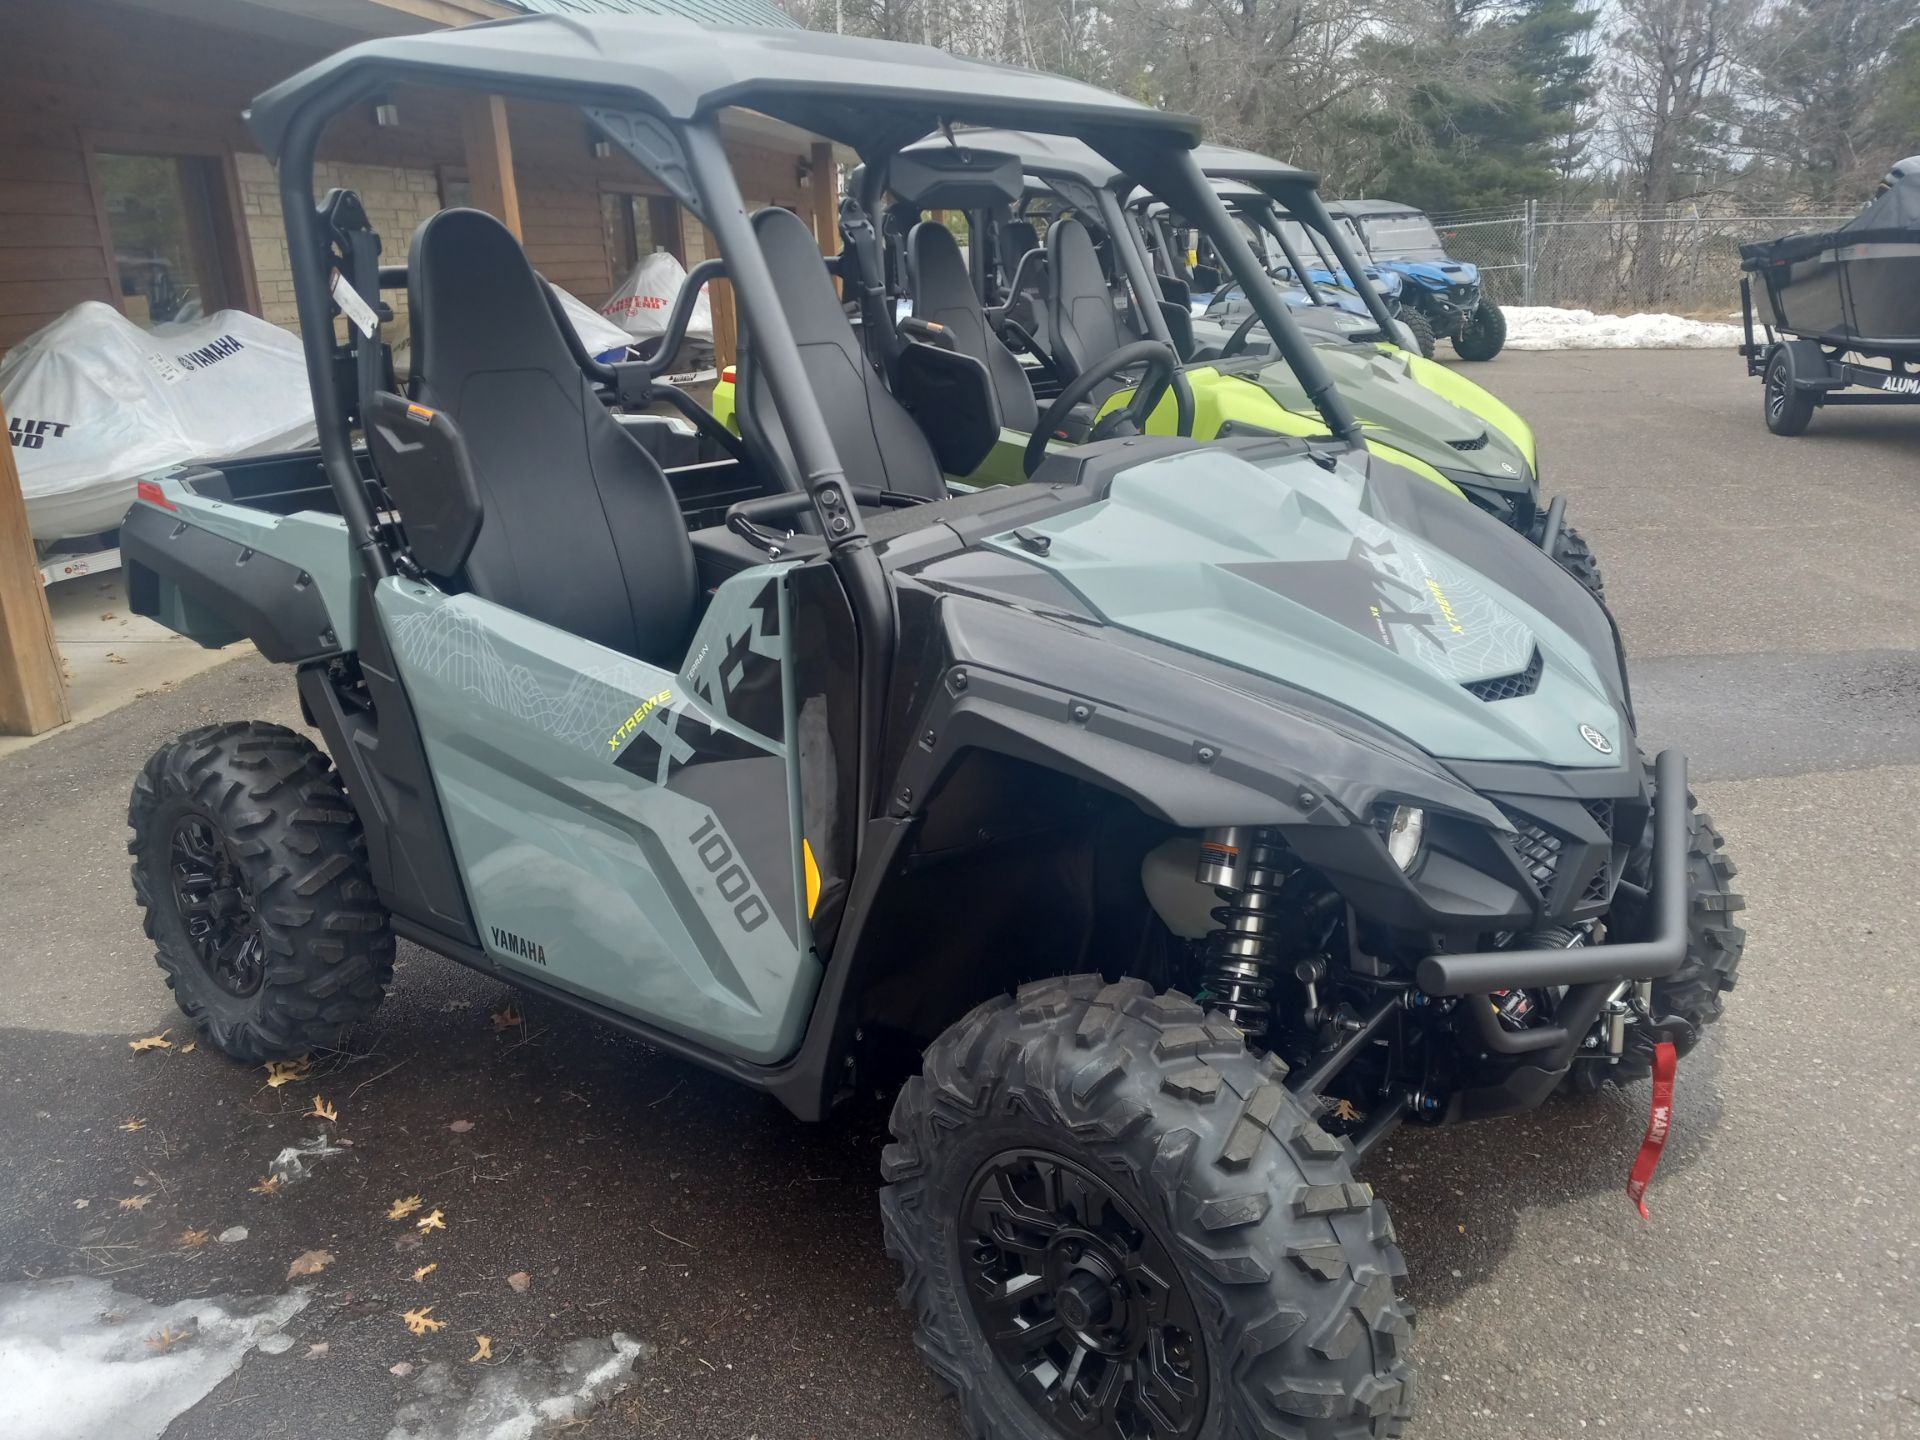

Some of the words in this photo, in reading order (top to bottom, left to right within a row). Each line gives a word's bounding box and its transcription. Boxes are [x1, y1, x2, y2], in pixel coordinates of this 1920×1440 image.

[184, 334, 245, 369] YAMAHA
[8, 431, 45, 449] ND
[9, 417, 70, 438] LIFT
[1425, 577, 1466, 636] XTREME
[608, 689, 672, 752] XTREME
[686, 644, 709, 682] TERRAIN
[689, 814, 769, 933] 1000
[491, 926, 546, 966] YAMAHA
[1647, 1106, 1669, 1144] WARN
